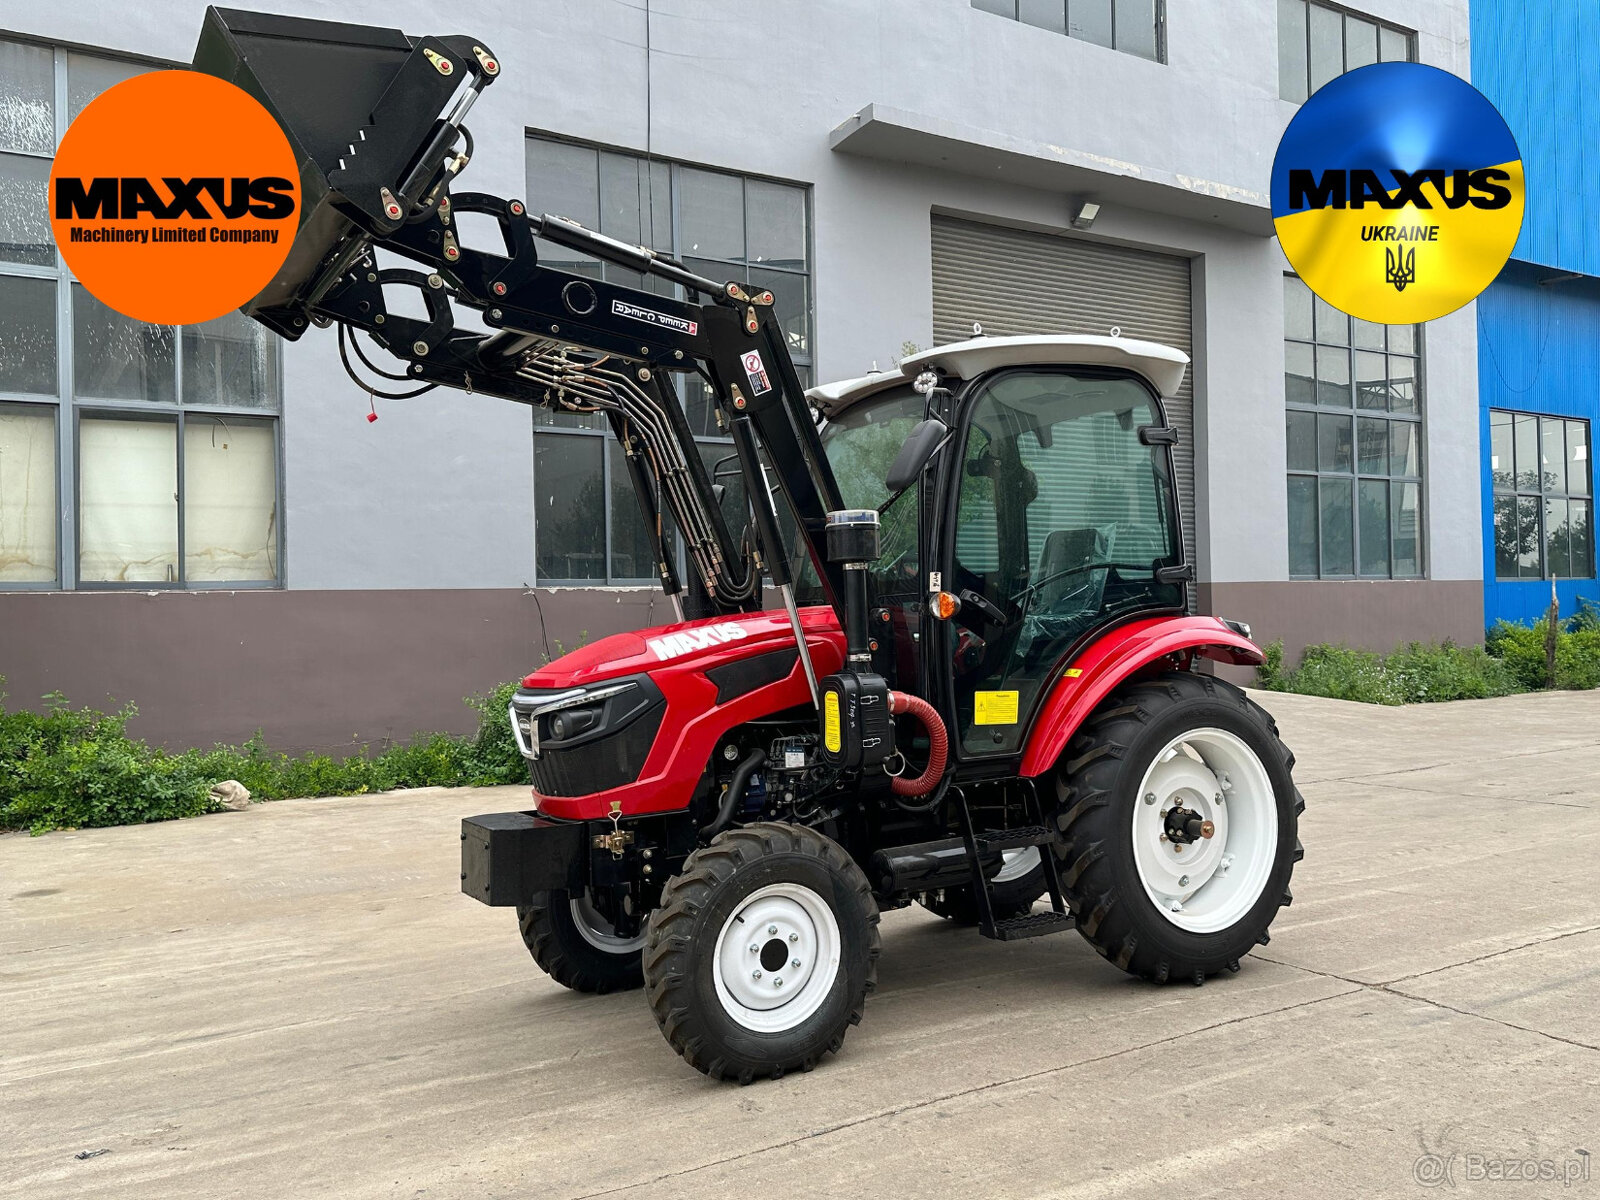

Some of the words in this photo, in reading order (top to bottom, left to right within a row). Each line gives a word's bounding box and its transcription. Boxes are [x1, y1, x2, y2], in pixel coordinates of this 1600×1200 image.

[615, 303, 656, 322] CLEAR
[657, 314, 689, 331] KEEP
[647, 621, 748, 662] MAXUS
